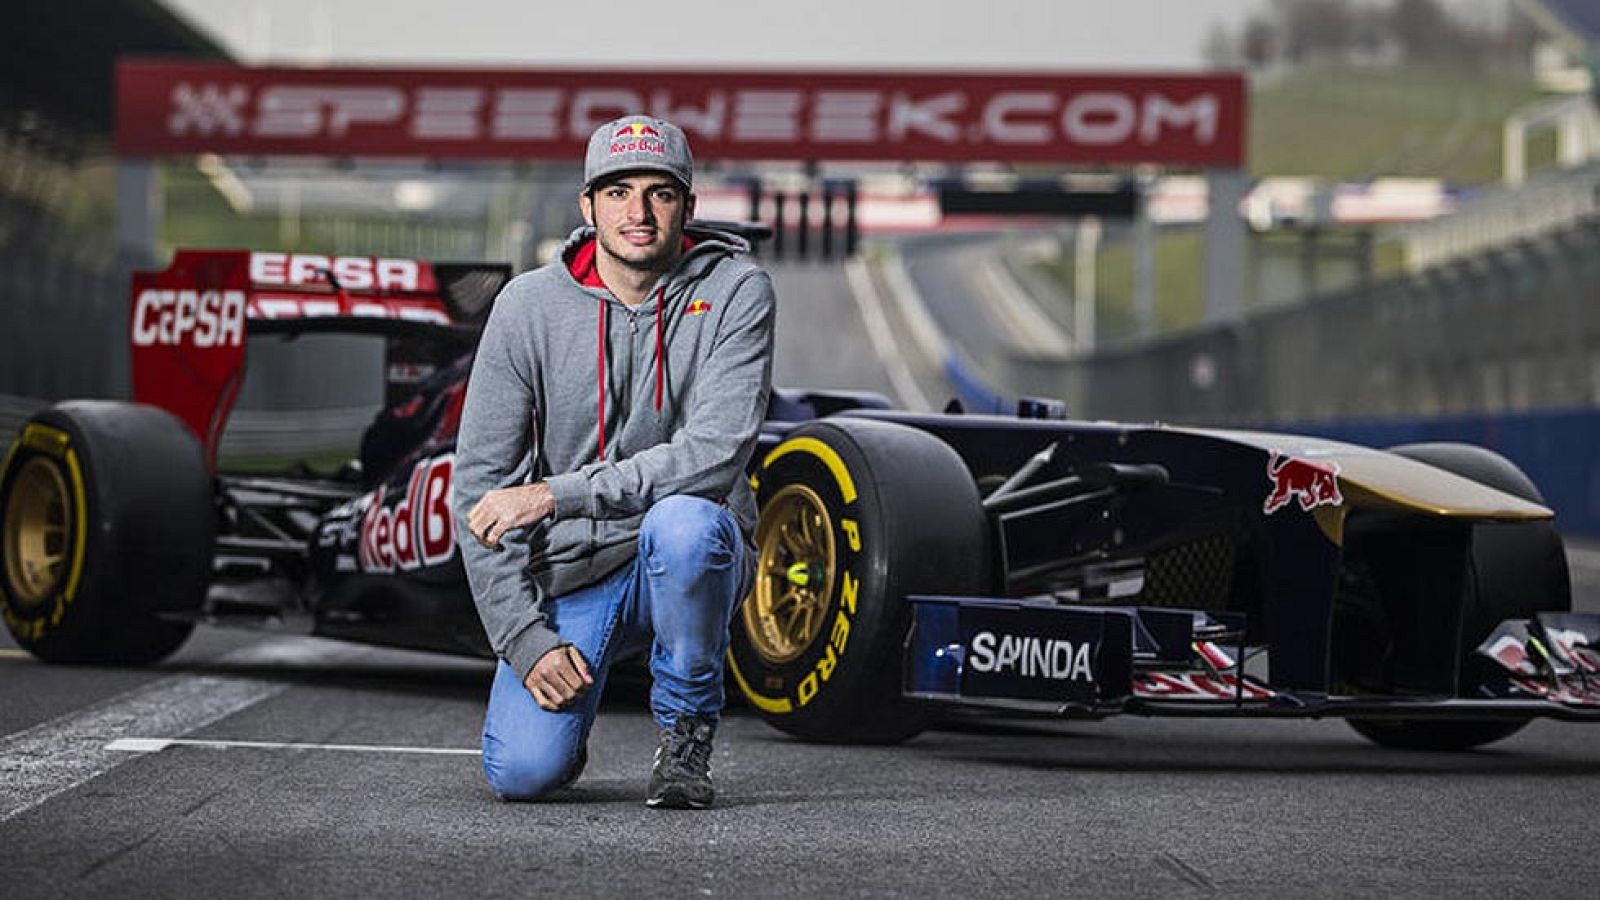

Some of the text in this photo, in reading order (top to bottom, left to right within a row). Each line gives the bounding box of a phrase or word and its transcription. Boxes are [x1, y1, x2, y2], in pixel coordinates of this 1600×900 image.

[251, 85, 1220, 143] SPEEDWEEK.COM
[610, 139, 665, 154] Red Bull
[133, 288, 246, 347] CEPSA
[797, 518, 862, 707] P ZERO
